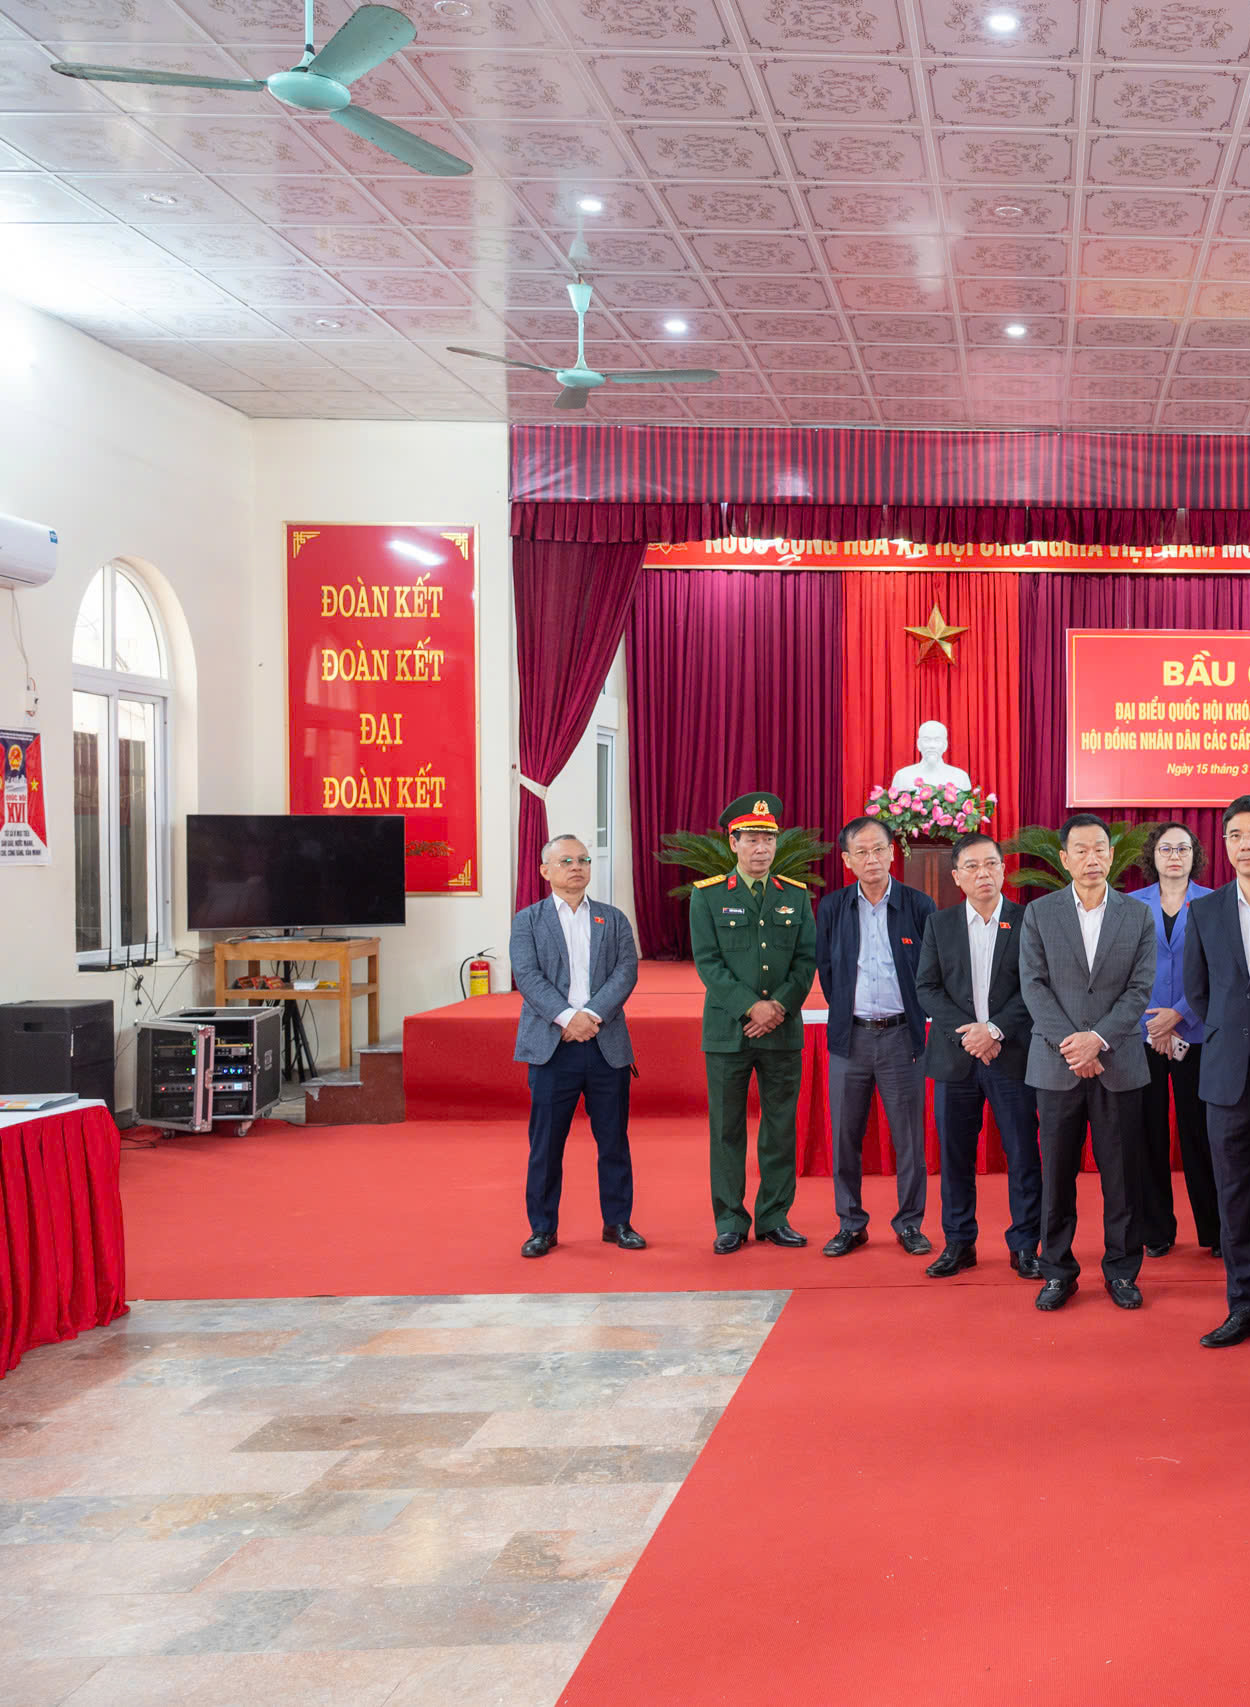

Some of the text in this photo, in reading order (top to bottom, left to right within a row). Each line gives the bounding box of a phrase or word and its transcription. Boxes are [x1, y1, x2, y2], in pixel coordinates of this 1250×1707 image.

[321, 572, 443, 618] ĐOÀN KẾT
[321, 636, 444, 681] ĐOÀN KẾT
[1163, 650, 1236, 687] BẦU
[1115, 701, 1136, 724] ĐẠI
[1138, 696, 1166, 721] BIỂU
[1168, 697, 1200, 721] QUỐC
[1202, 699, 1223, 724] HỘI
[359, 712, 403, 752] ĐẠI
[1081, 728, 1101, 754] HỘI
[1104, 726, 1137, 750] ĐỒNG
[1140, 729, 1173, 750] NHÂN
[1176, 729, 1201, 750] DÂN
[1203, 729, 1227, 750] CÁC
[323, 762, 446, 808] ĐOÀN KẾT
[1166, 763, 1193, 776] Ngày
[1196, 763, 1208, 774] 15
[1210, 762, 1240, 776] tháng
[1242, 763, 1249, 774] 3
[7, 803, 25, 823] XVI
